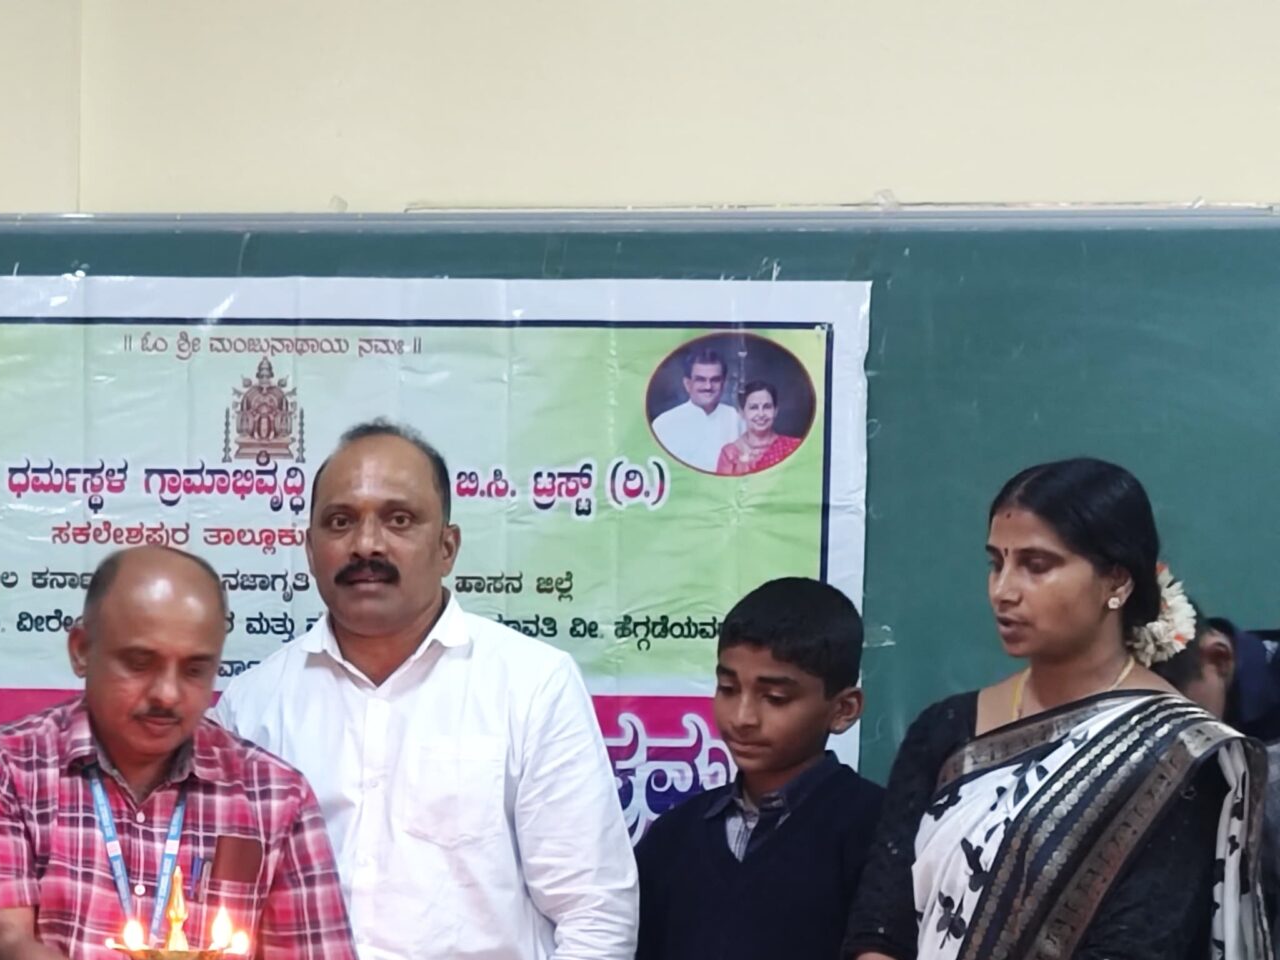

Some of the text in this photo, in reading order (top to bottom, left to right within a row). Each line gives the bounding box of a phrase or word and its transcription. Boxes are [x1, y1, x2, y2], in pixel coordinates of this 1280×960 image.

[176, 331, 201, 360] ಶ್ರೀ
[209, 335, 350, 357] ಮಂಜುನಾಥಾಯ
[8, 457, 128, 514] ಧರ್ಮಸ್ಥಳ
[533, 463, 593, 516] ಟ್ರಸ್ಟ್
[610, 460, 666, 506] (ರಿ.)
[52, 520, 305, 555] ಸಕಲೇಶಪುರ ತಾಲ್ಲೂಕು
[221, 568, 311, 602] ನಜಾಗೃತಿ
[455, 571, 523, 594] ಹಾಸನ
[536, 570, 574, 602] ಜಿಲ್ಲೆ
[246, 611, 295, 644] ಮತ್ತು
